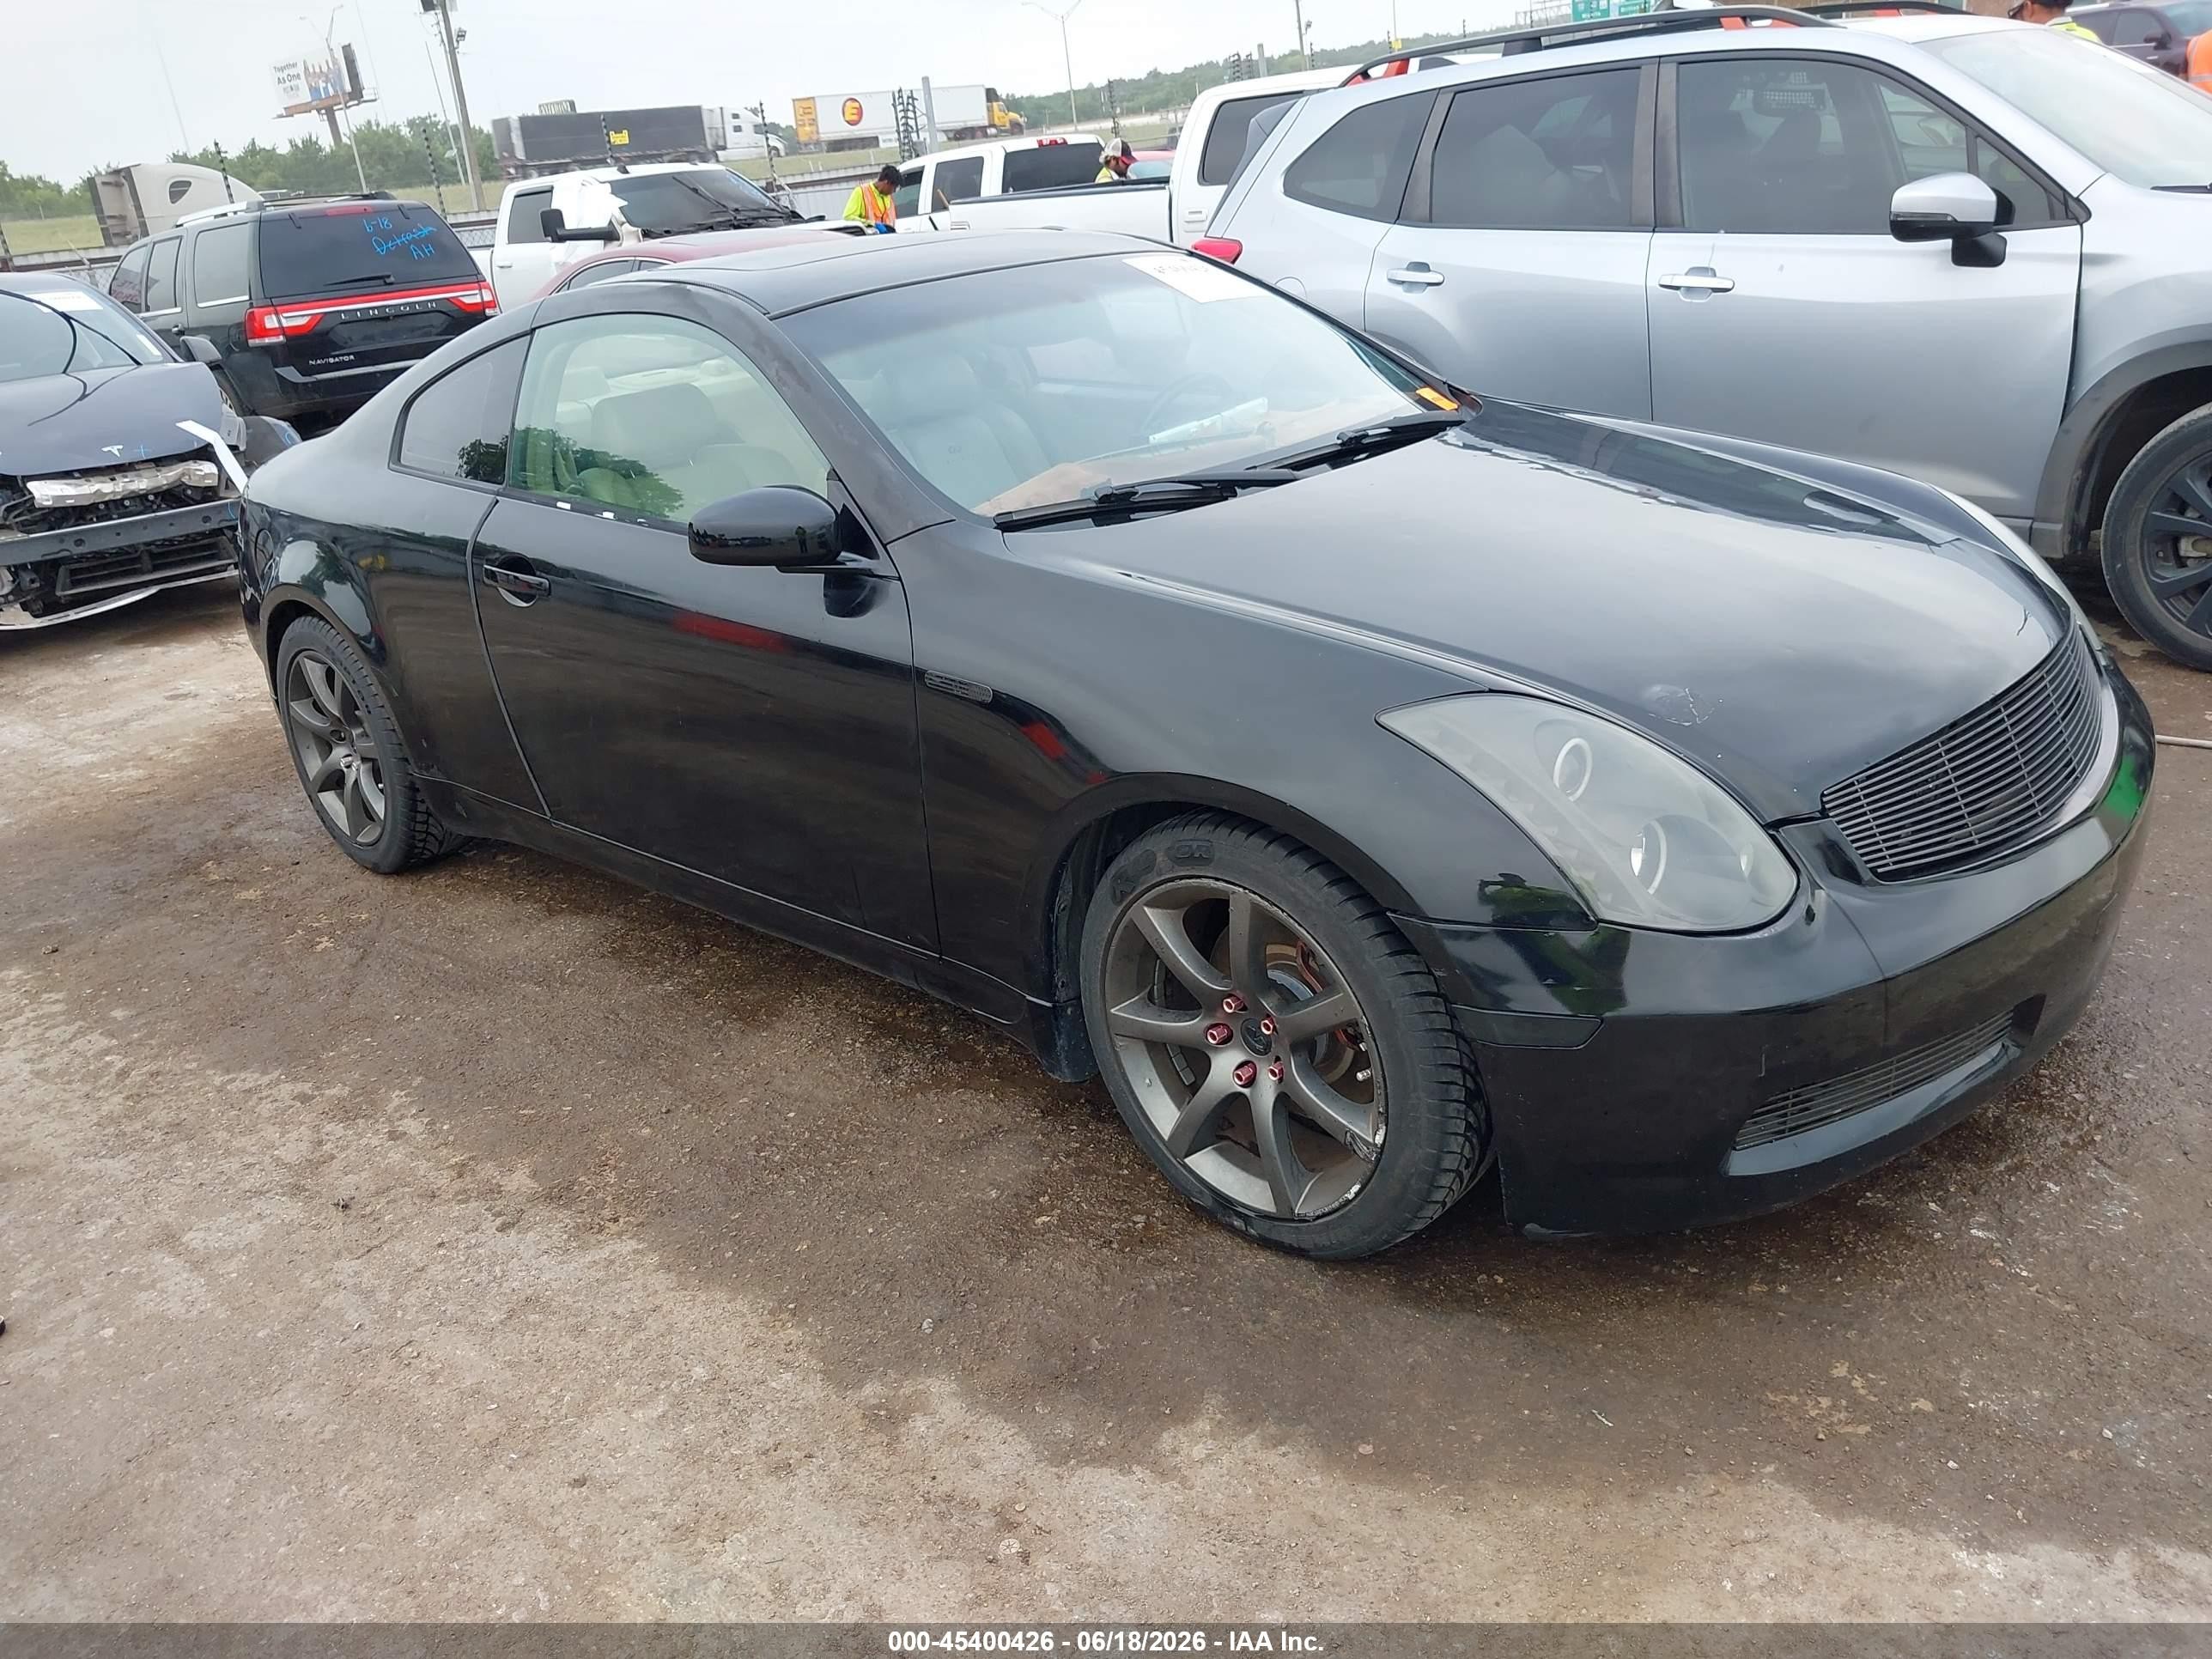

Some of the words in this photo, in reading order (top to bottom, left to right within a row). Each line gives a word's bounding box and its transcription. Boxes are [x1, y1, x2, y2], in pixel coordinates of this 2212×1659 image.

[273, 62, 298, 74] Together
[277, 76, 287, 86] As
[286, 73, 301, 83] One
[409, 243, 435, 261] AH
[340, 301, 437, 320] LINCOLN
[308, 355, 356, 365] NAVIGATOR
